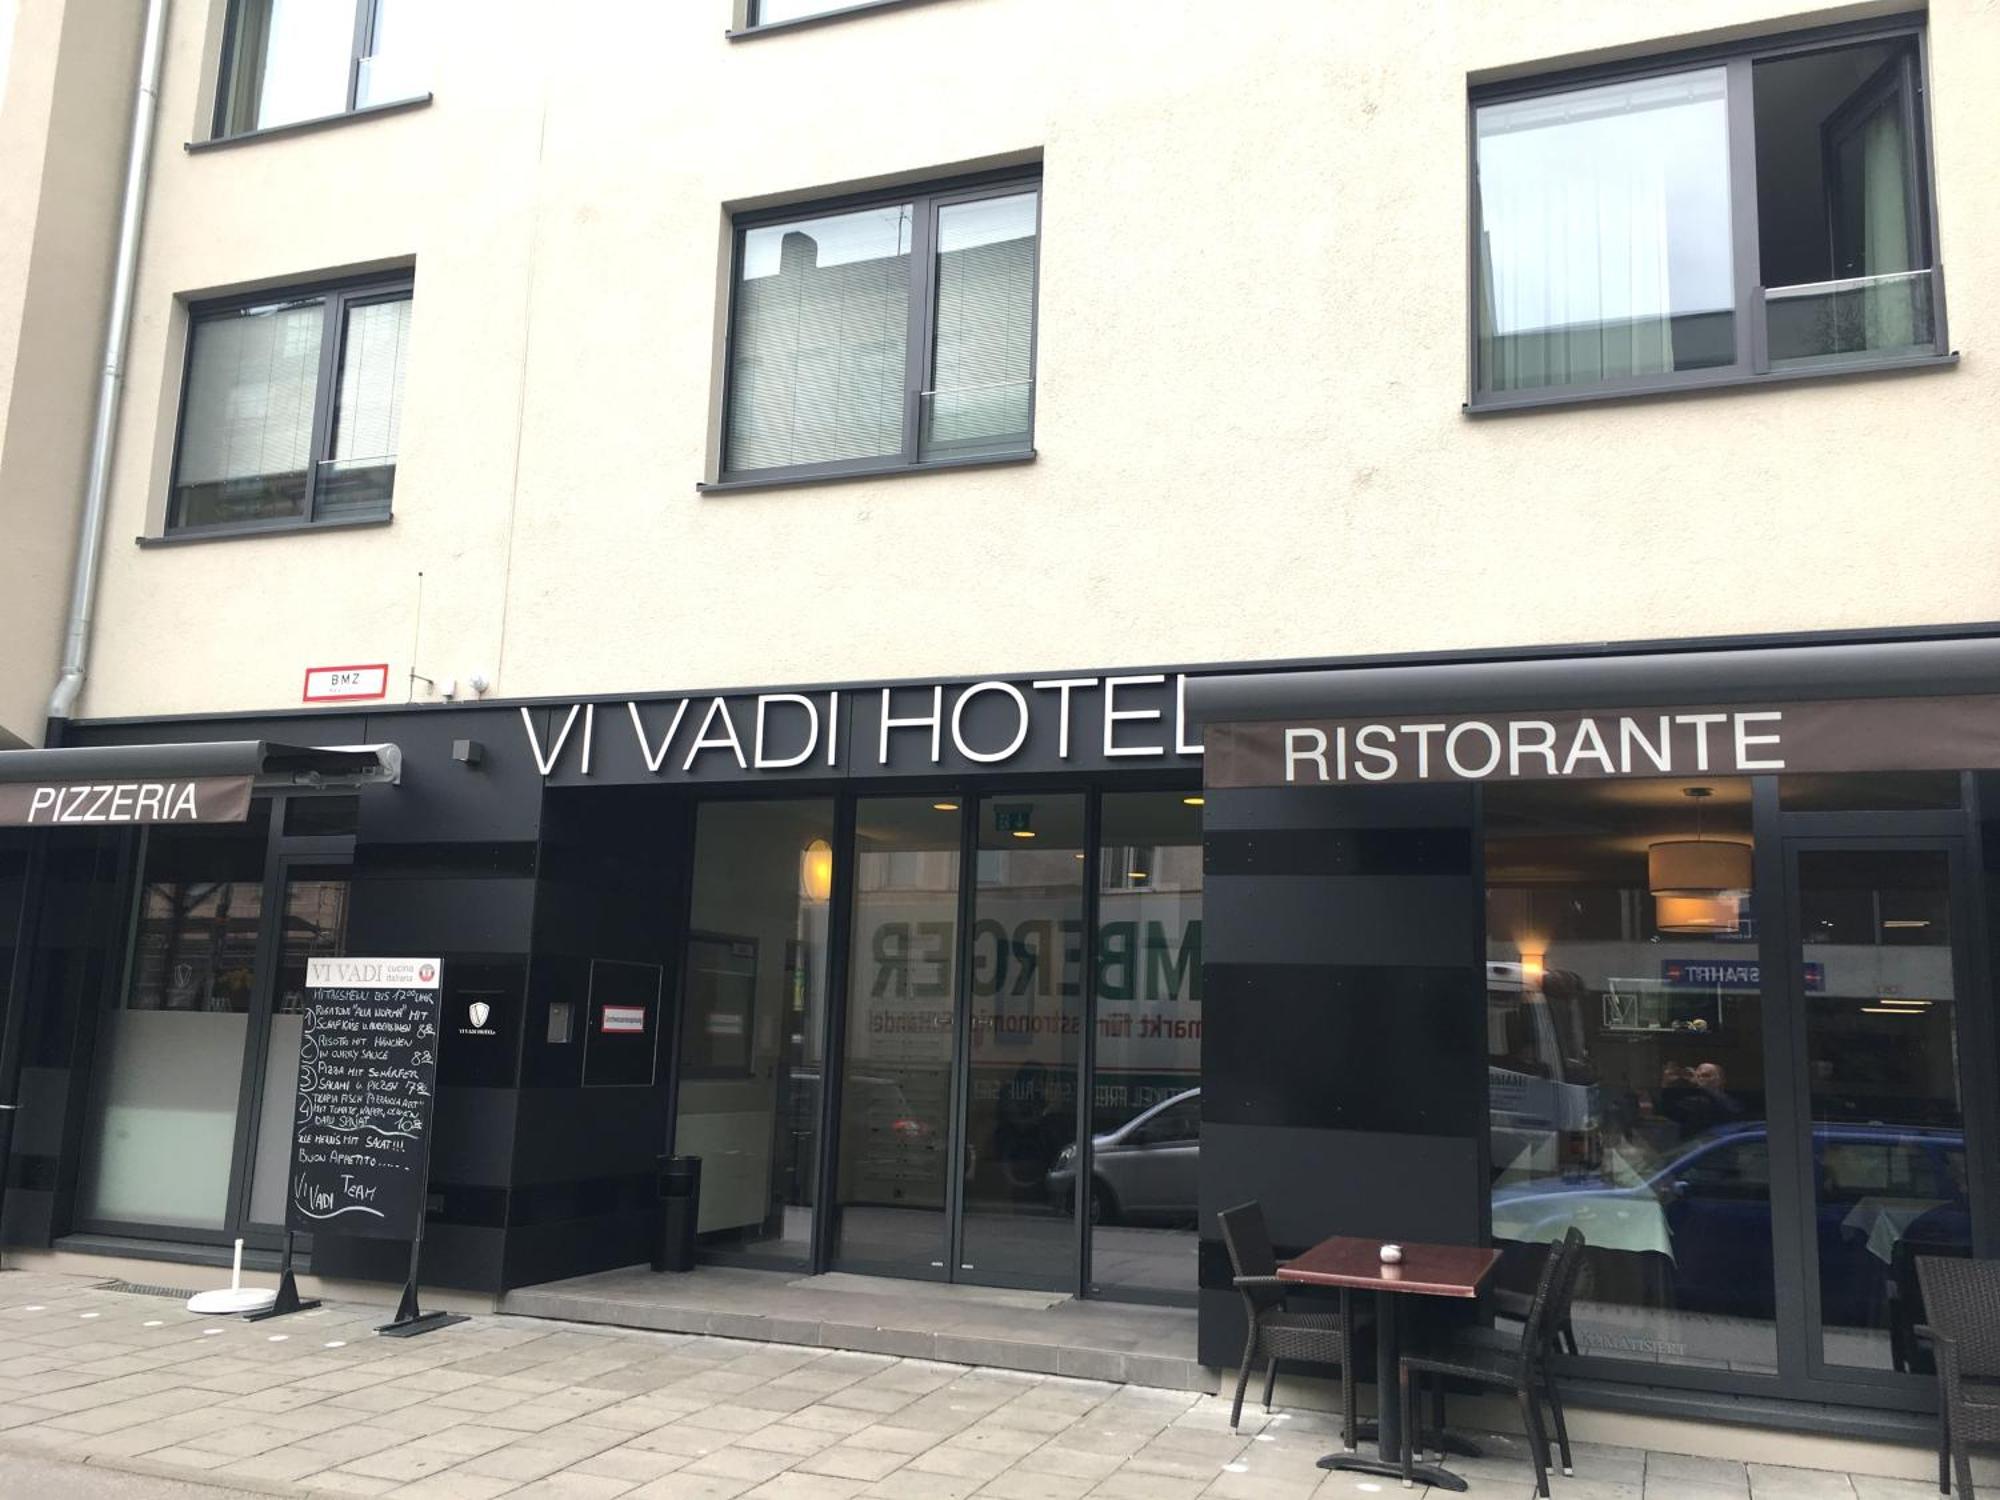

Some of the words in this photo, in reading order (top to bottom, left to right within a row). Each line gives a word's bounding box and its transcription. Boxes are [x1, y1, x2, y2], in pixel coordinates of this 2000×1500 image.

[331, 672, 360, 686] BMZ
[520, 703, 594, 775] VI
[628, 691, 838, 772] VADI
[879, 674, 1205, 763] HOTEL
[1284, 711, 1786, 782] RISTORANTE
[27, 783, 198, 823] PIZZERIA
[335, 963, 384, 983] VADI
[300, 1148, 327, 1163] BUON
